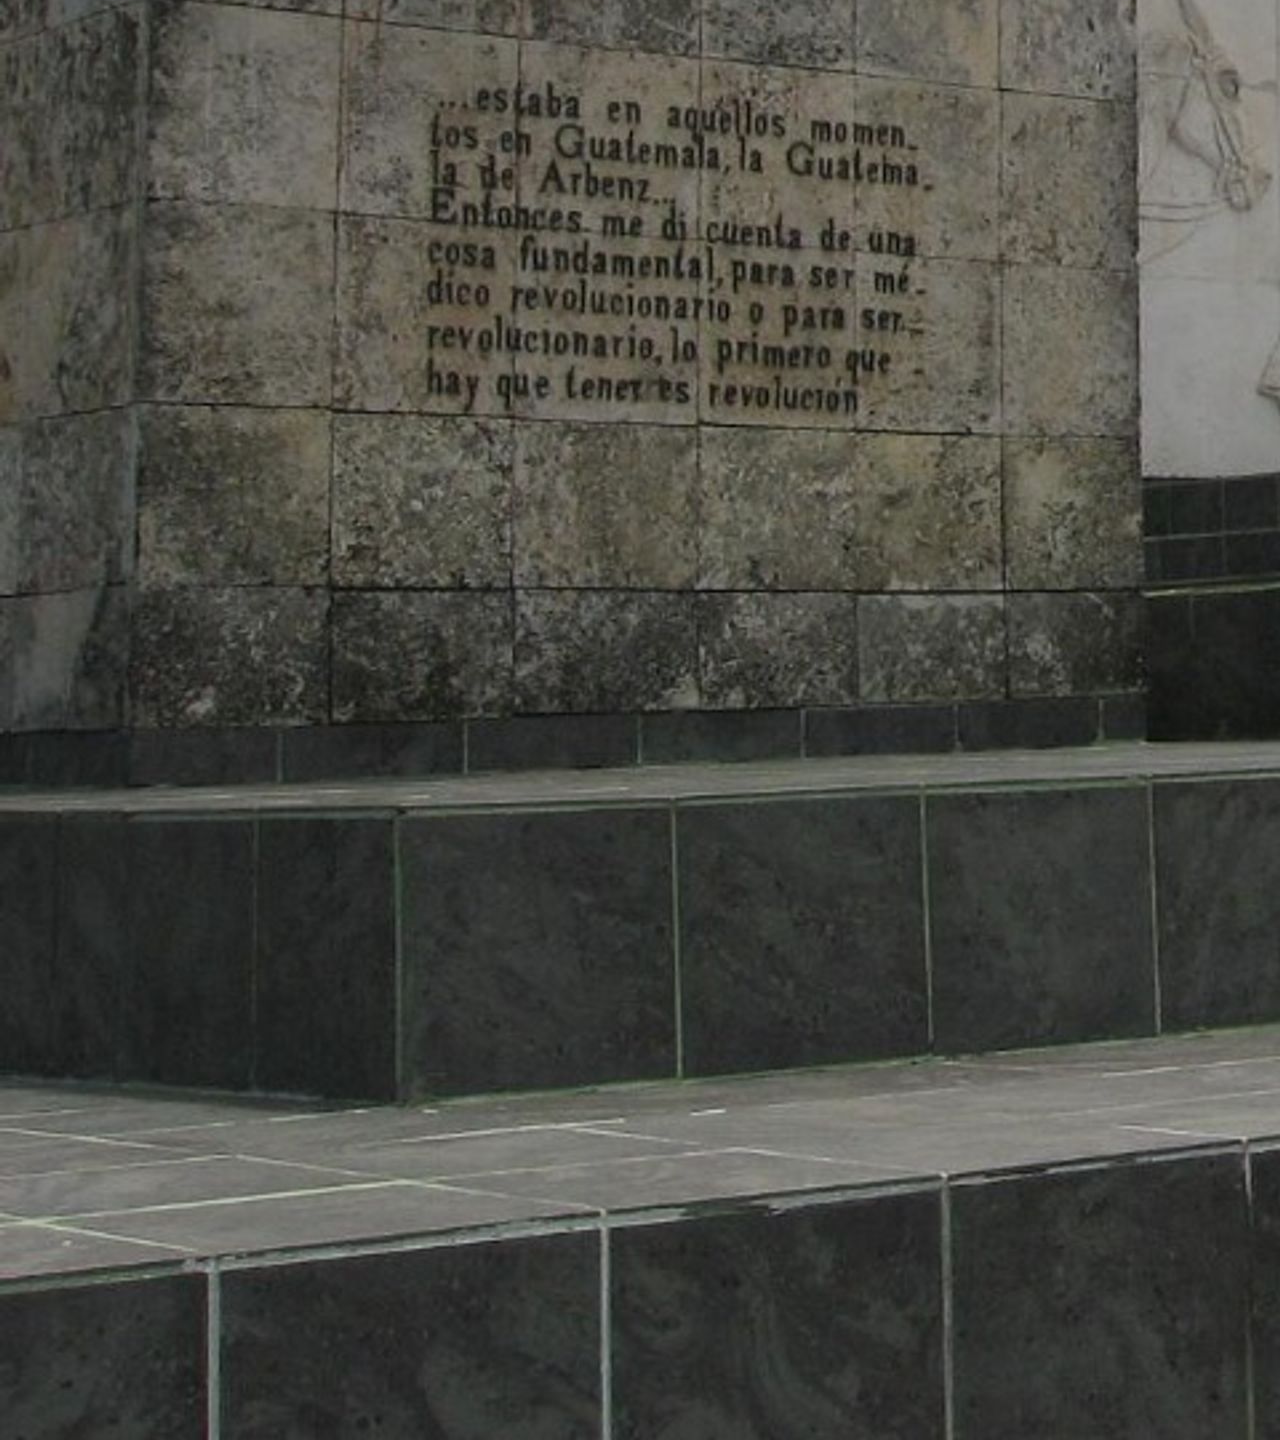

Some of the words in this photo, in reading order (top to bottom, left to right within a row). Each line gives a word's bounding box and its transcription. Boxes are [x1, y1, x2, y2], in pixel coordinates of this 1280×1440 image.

[607, 100, 641, 124] en
[430, 112, 479, 149] tos
[500, 130, 532, 156] en
[554, 124, 730, 175] Guatemala,
[739, 136, 763, 173] la
[430, 149, 456, 185] la
[479, 154, 514, 190] de
[430, 187, 583, 234] Entonces
[602, 214, 643, 237] me
[661, 205, 687, 240] di
[707, 212, 801, 250] cuenta
[821, 218, 852, 251] de
[869, 231, 916, 257] una
[427, 241, 496, 269] cosa
[520, 234, 724, 289] fundamental,
[731, 259, 795, 293] para
[809, 265, 855, 289] ser
[427, 268, 490, 306] dico
[511, 278, 730, 323] revolucionario
[750, 301, 764, 324] o
[782, 303, 845, 336] para
[670, 326, 697, 363] lo
[717, 333, 831, 375] primero
[426, 358, 479, 411] hay
[496, 371, 550, 410] que
[566, 365, 642, 402] tener
[658, 374, 690, 403] es
